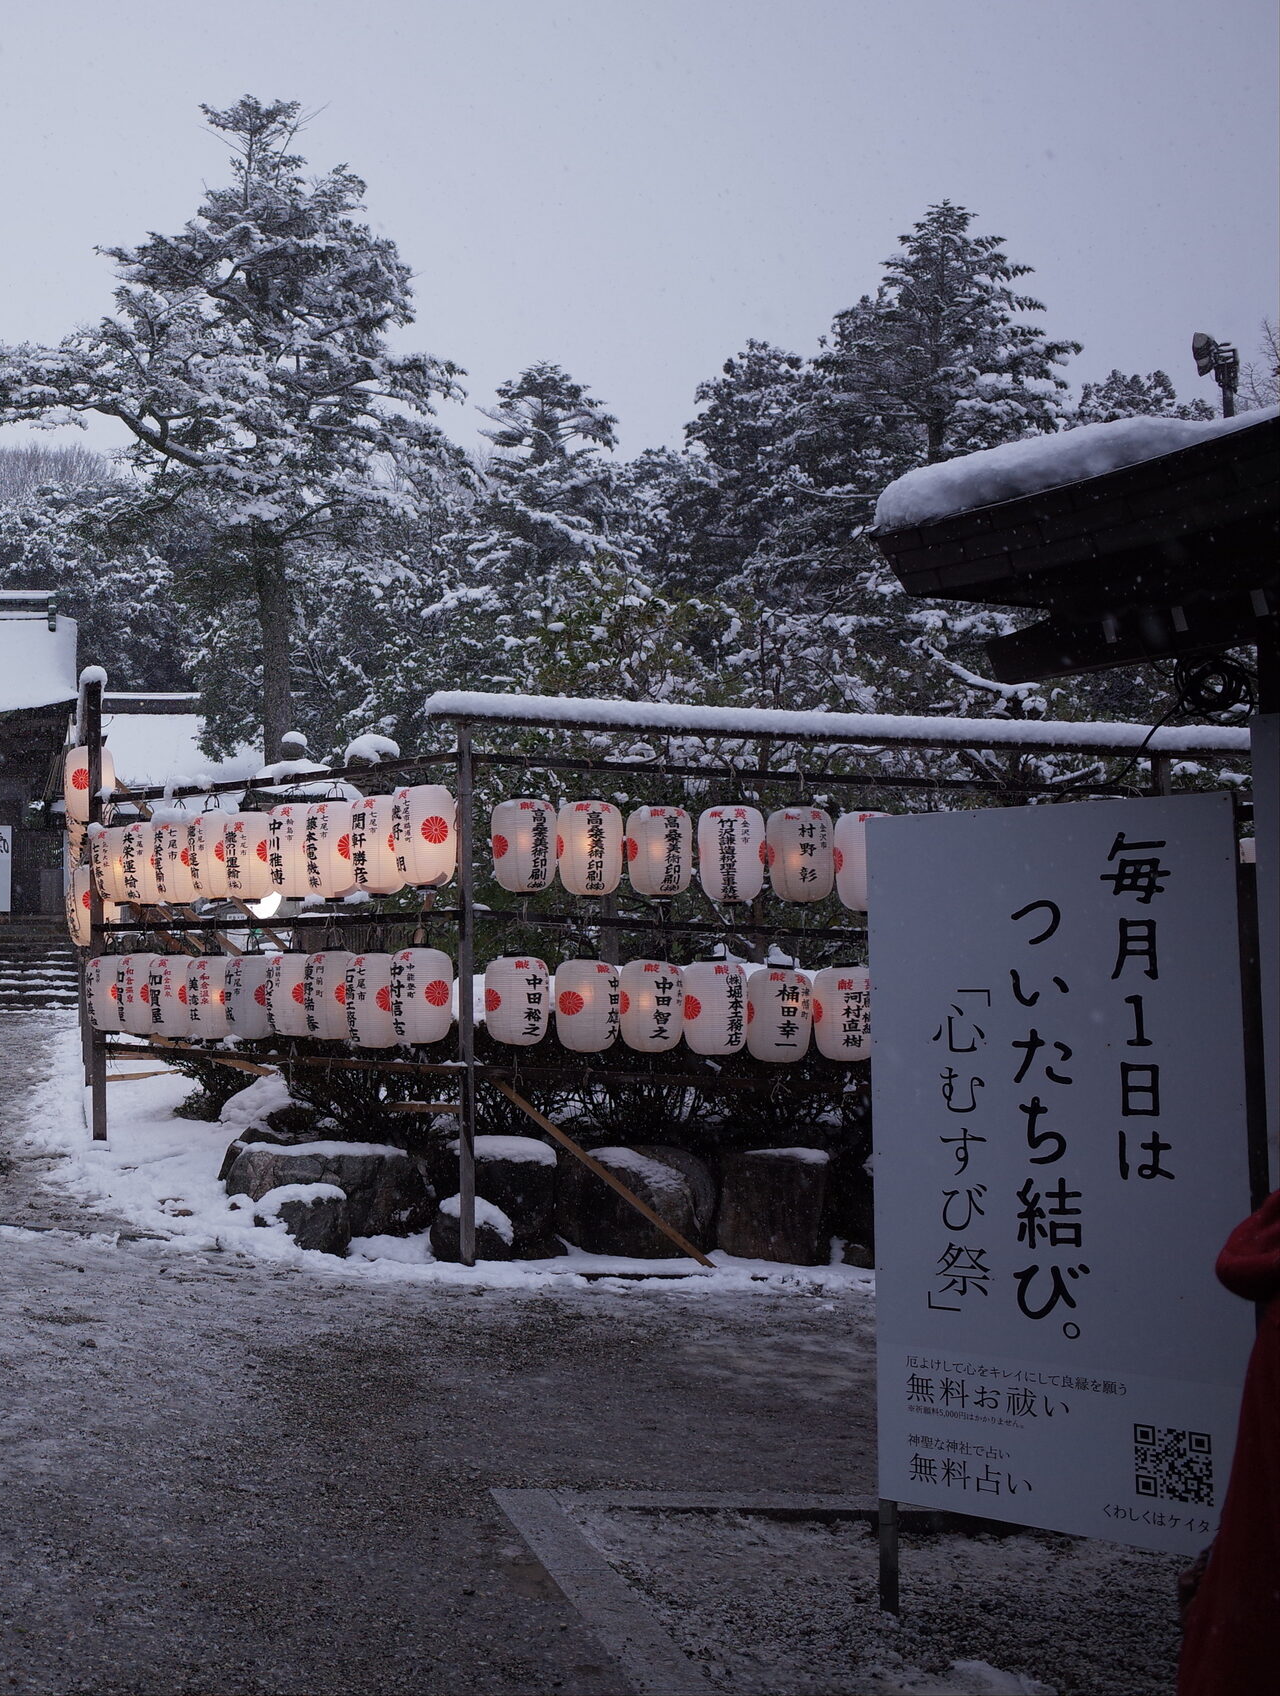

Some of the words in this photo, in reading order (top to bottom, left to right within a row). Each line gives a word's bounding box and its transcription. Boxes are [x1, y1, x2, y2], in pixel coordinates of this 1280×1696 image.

[168, 828, 178, 862] 七尾市
[148, 969, 165, 1024] 加賀屋
[356, 967, 367, 1001] 七尾市
[522, 973, 543, 1037] 中田裕之
[649, 976, 674, 1040] 中田智之
[1100, 832, 1175, 1181] 毎月1日は
[775, 983, 800, 1047] 桶田幸一
[841, 991, 864, 1048] 河村直樹
[1010, 899, 1091, 1340] ついたち結び。
[906, 1373, 1070, 1417] 無料お祓い
[907, 1433, 1011, 1459] 神聖な神社で占い
[909, 1453, 1033, 1496] 無料占い
